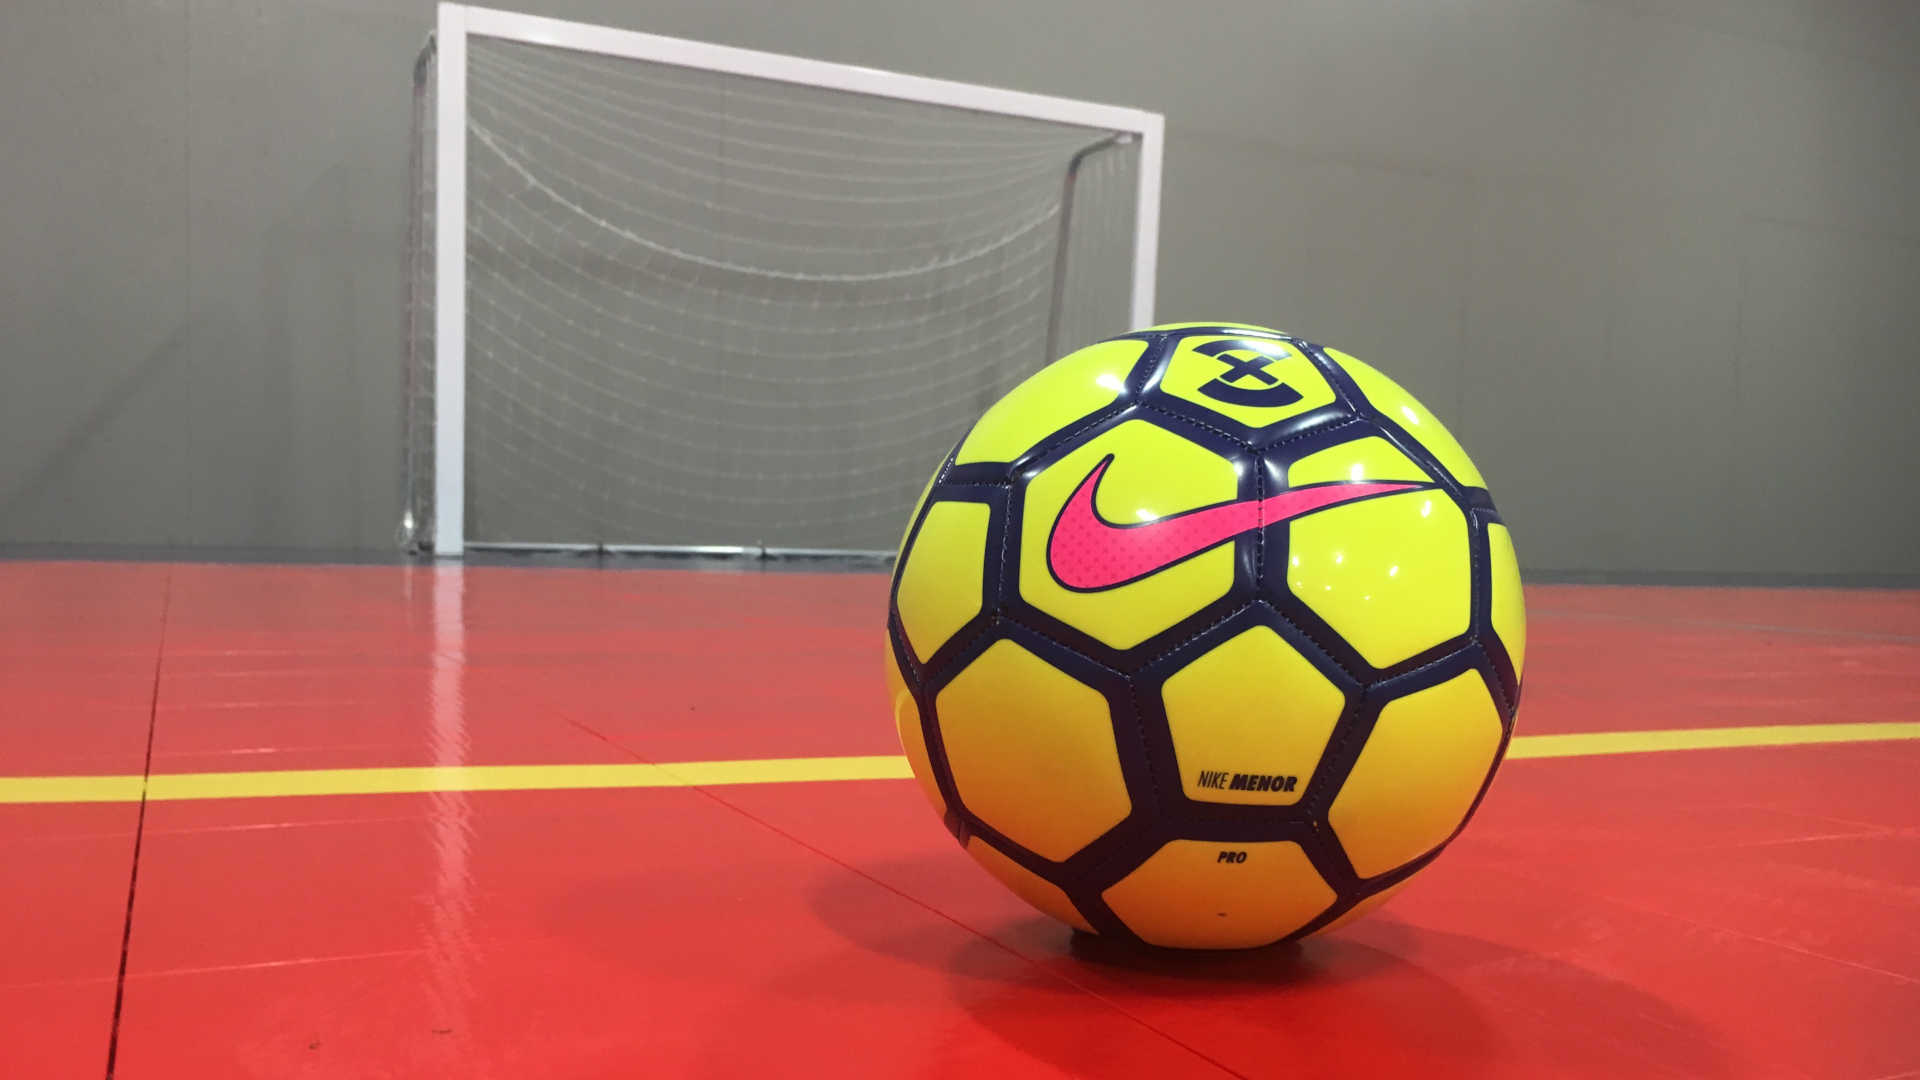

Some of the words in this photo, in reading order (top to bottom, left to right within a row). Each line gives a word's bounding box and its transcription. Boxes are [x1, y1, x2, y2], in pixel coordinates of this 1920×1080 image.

[1197, 770, 1229, 789] NIKE
[1229, 773, 1298, 792] MENOR
[1217, 851, 1247, 864] PRO
